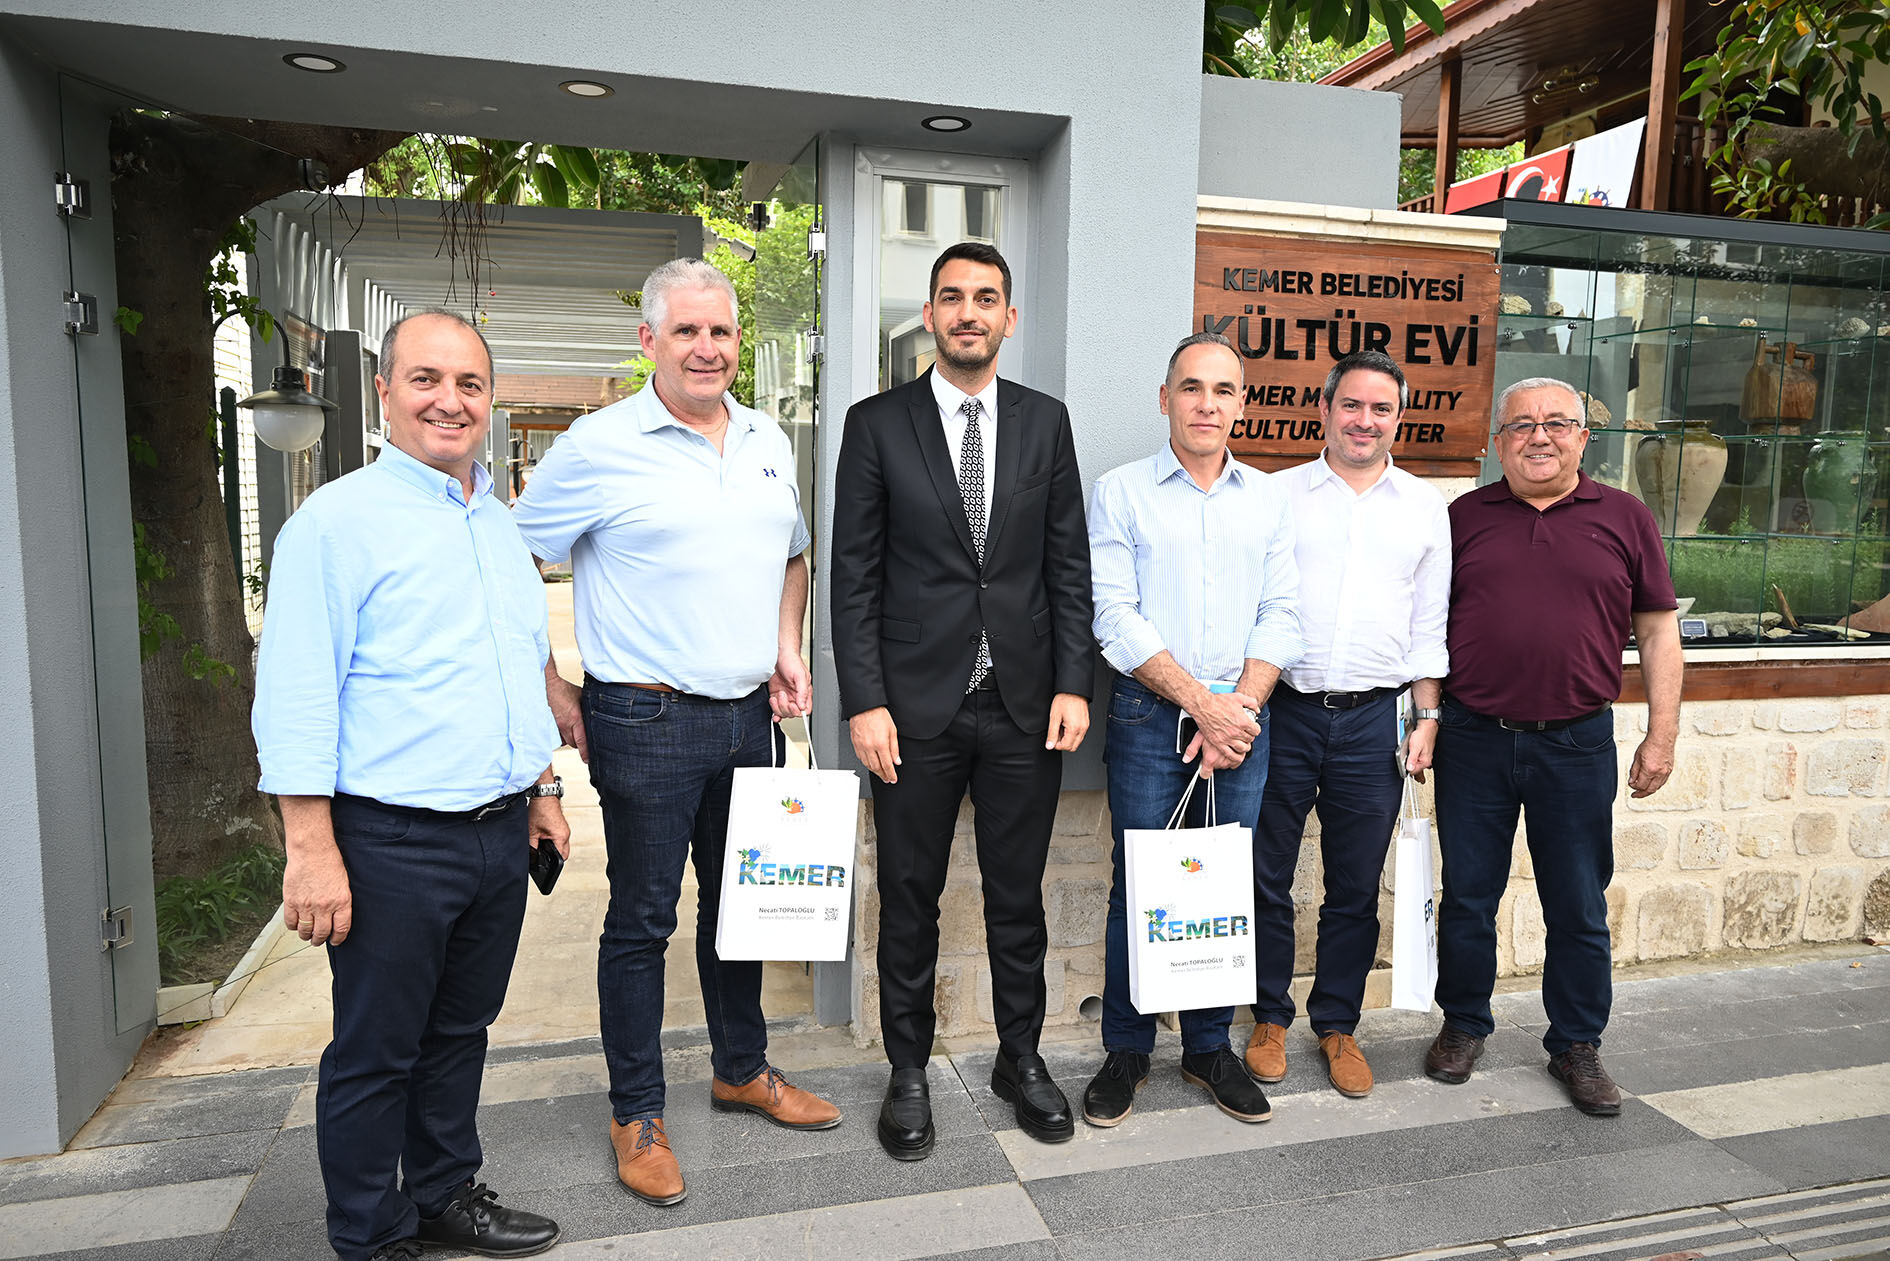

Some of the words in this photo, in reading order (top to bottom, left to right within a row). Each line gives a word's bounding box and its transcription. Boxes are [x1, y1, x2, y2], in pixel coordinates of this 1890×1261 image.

[1223, 267, 1314, 295] KEMER
[1320, 270, 1464, 303] BELEDİYESİ
[1405, 314, 1479, 366] EVİ
[1243, 385, 1297, 407] MER
[1229, 419, 1326, 441] CULTUR
[738, 863, 846, 888] KEMER
[1148, 915, 1249, 943] KEMER
